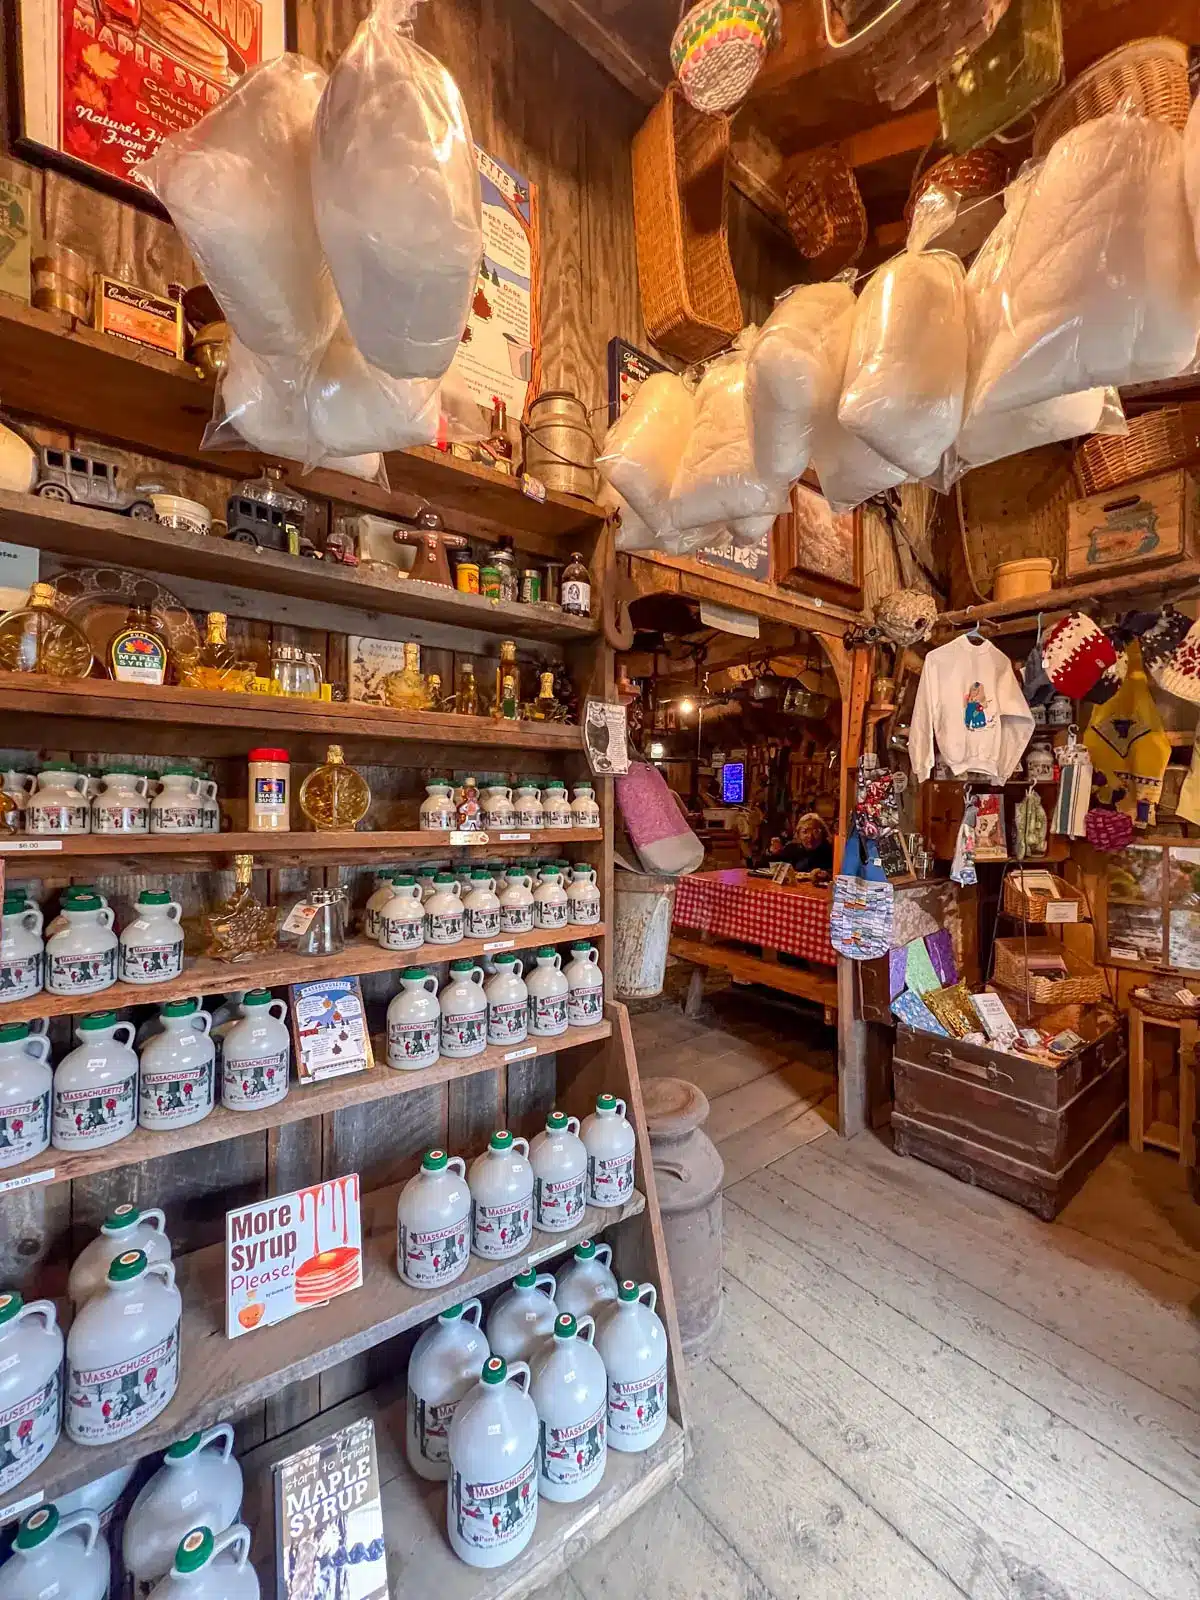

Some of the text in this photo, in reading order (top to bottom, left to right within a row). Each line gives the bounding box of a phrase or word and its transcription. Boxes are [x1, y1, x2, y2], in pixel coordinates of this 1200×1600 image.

[74, 8, 227, 106] MAPLE SYR
[143, 77, 204, 117] GOLDEN
[150, 95, 197, 127] SWEET
[75, 105, 141, 137] Nature's
[103, 129, 147, 153] From
[118, 654, 160, 663] MAPLE
[119, 659, 161, 669] SYRUP
[145, 1071, 200, 1084] MASSACHUSETTS
[231, 1057, 280, 1070] MASSACHUSETTS
[63, 1086, 123, 1101] MASSACHUSETTS
[231, 1204, 292, 1243] More
[231, 1230, 297, 1272] Syrup
[231, 1256, 296, 1296] Please!
[82, 1345, 167, 1385] MASSACHUSETTS
[107, 1417, 133, 1430] Maple
[285, 1444, 370, 1492] start to finish
[476, 1463, 533, 1498] MASSACHUSETTS
[286, 1456, 371, 1518] MAPLE
[289, 1480, 368, 1538] SYRUP
